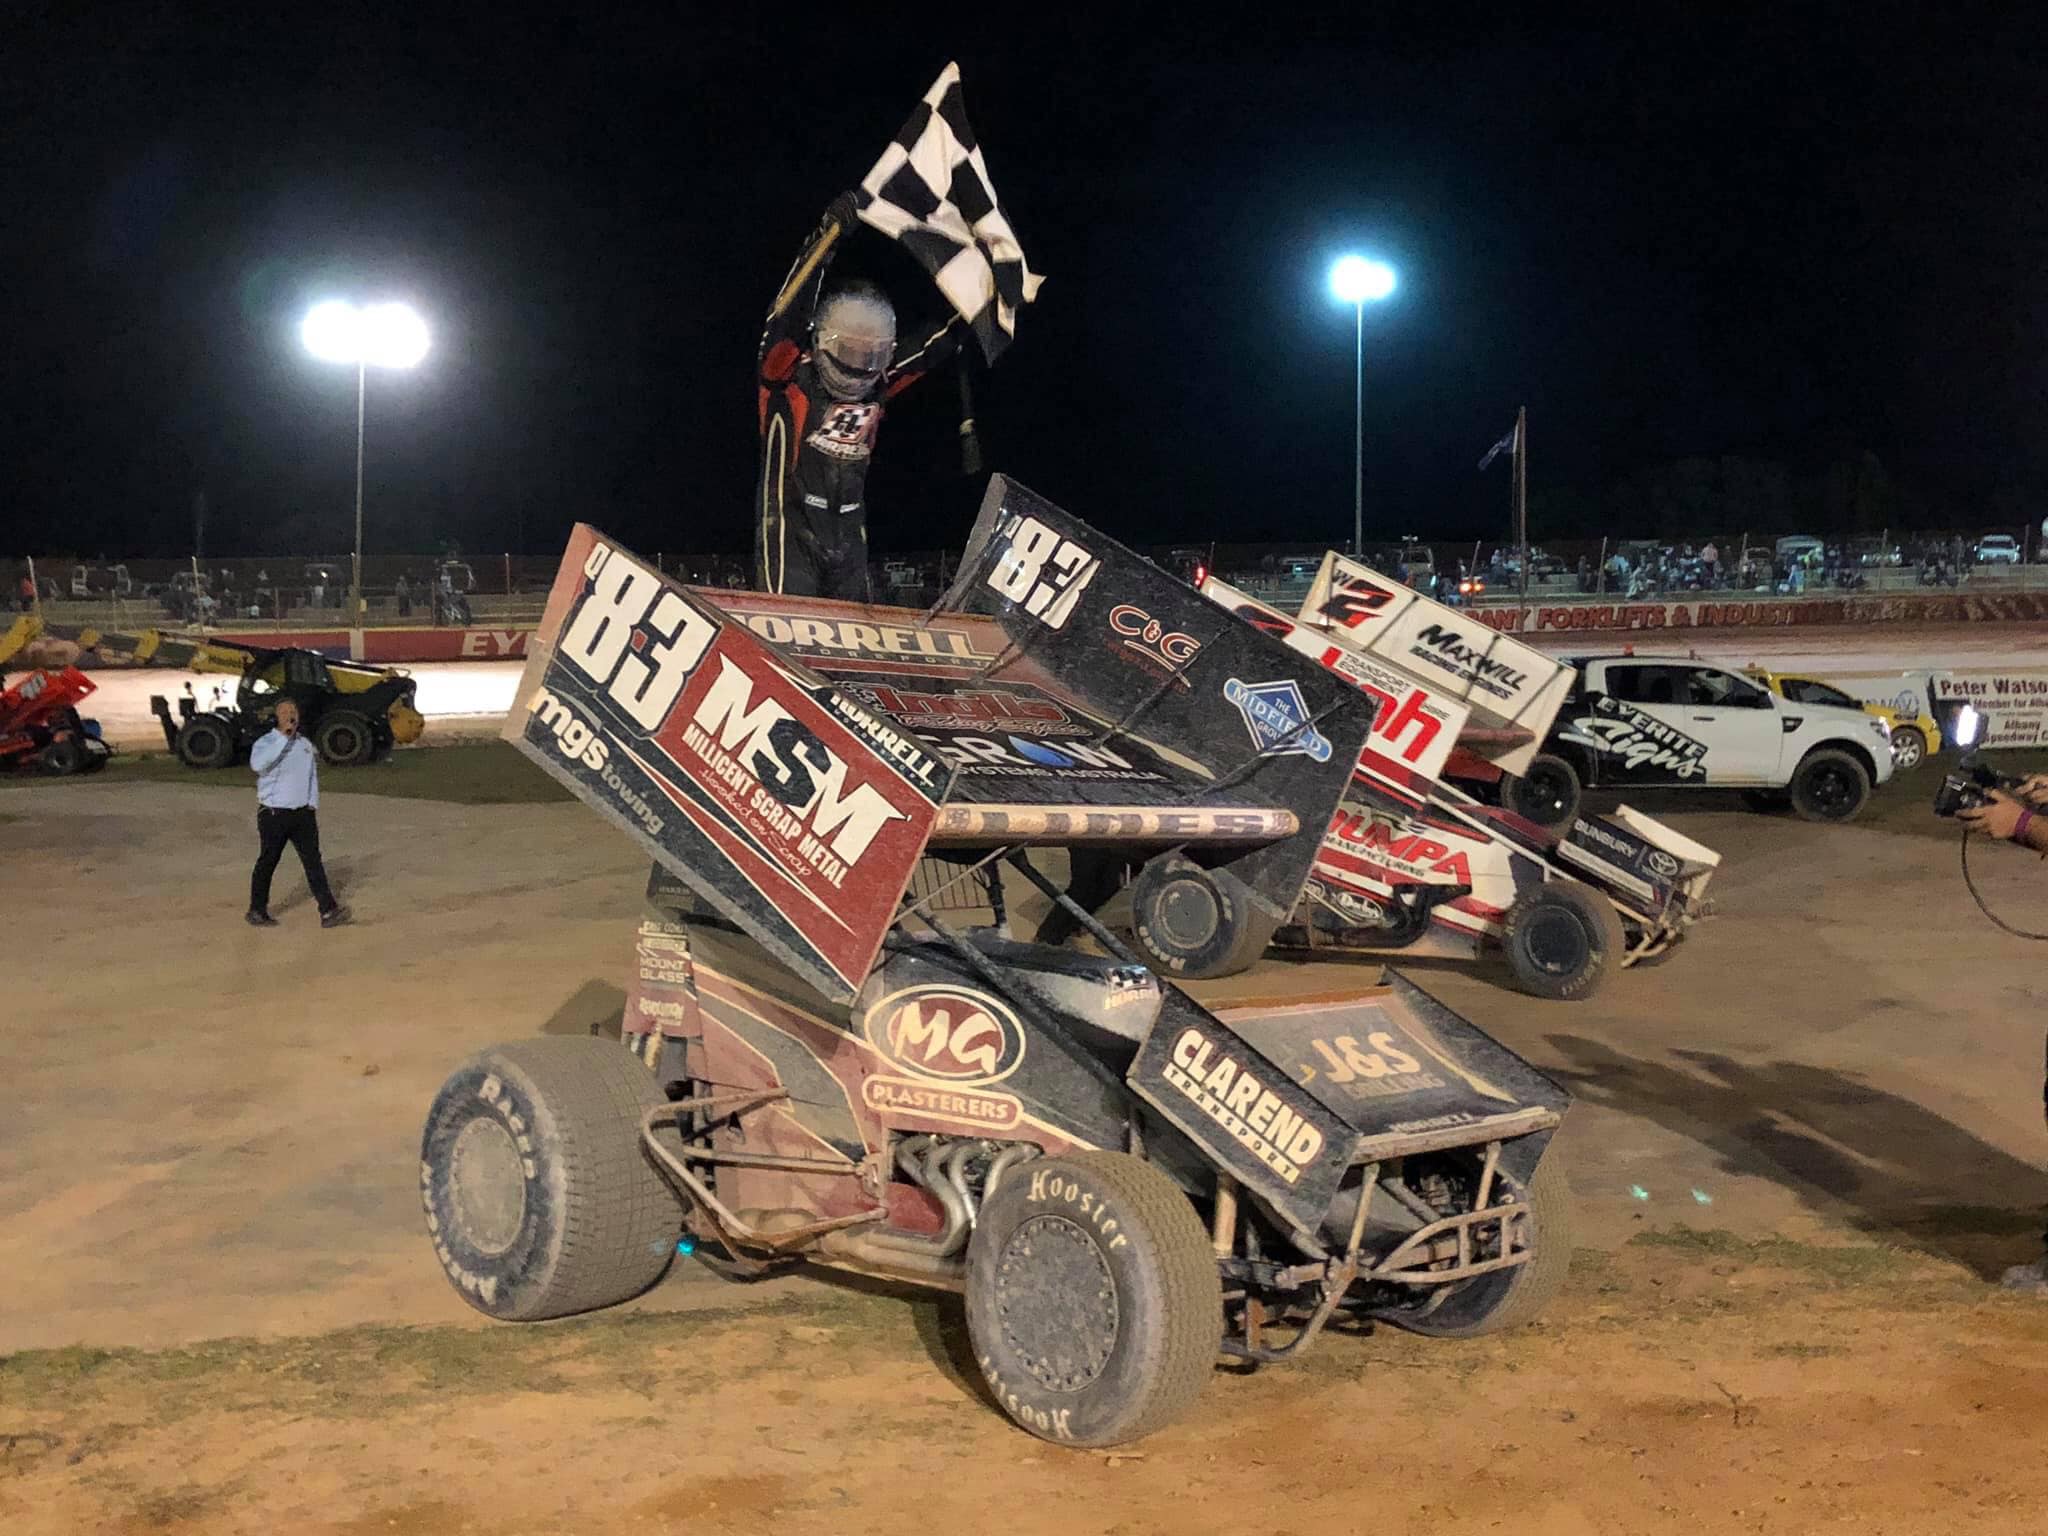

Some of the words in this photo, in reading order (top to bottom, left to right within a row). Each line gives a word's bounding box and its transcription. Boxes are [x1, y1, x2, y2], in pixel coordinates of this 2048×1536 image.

[987, 517, 1100, 630] 83
[1317, 579, 1396, 629] 2
[1466, 608, 1531, 629] BANY
[1537, 605, 1666, 629] FORKLIFTS
[461, 631, 528, 656] EY
[560, 550, 716, 730] 83
[737, 614, 995, 659] ORRELL
[796, 646, 986, 667] TORSPORT
[1344, 654, 1411, 687] TRANSPORT
[1940, 680, 1987, 696] Peter
[526, 686, 610, 771] mgs
[1274, 698, 1290, 713] THE
[1597, 696, 1708, 757] EVERITE
[1256, 722, 1284, 742] GROU
[1573, 717, 1705, 778] Signs
[693, 652, 912, 867] MSM
[601, 763, 665, 835] towing
[681, 723, 754, 796] MILLICENT
[750, 788, 802, 840] SCRAP
[797, 834, 847, 889] METAL
[1575, 818, 1638, 857] BUNBURY
[894, 1001, 997, 1074] MG
[1312, 1031, 1421, 1083] J&S
[872, 1084, 1009, 1119] PLASTERERS
[1169, 1069, 1292, 1174] TRANSPORT
[1173, 1029, 1322, 1165] CLAREND
